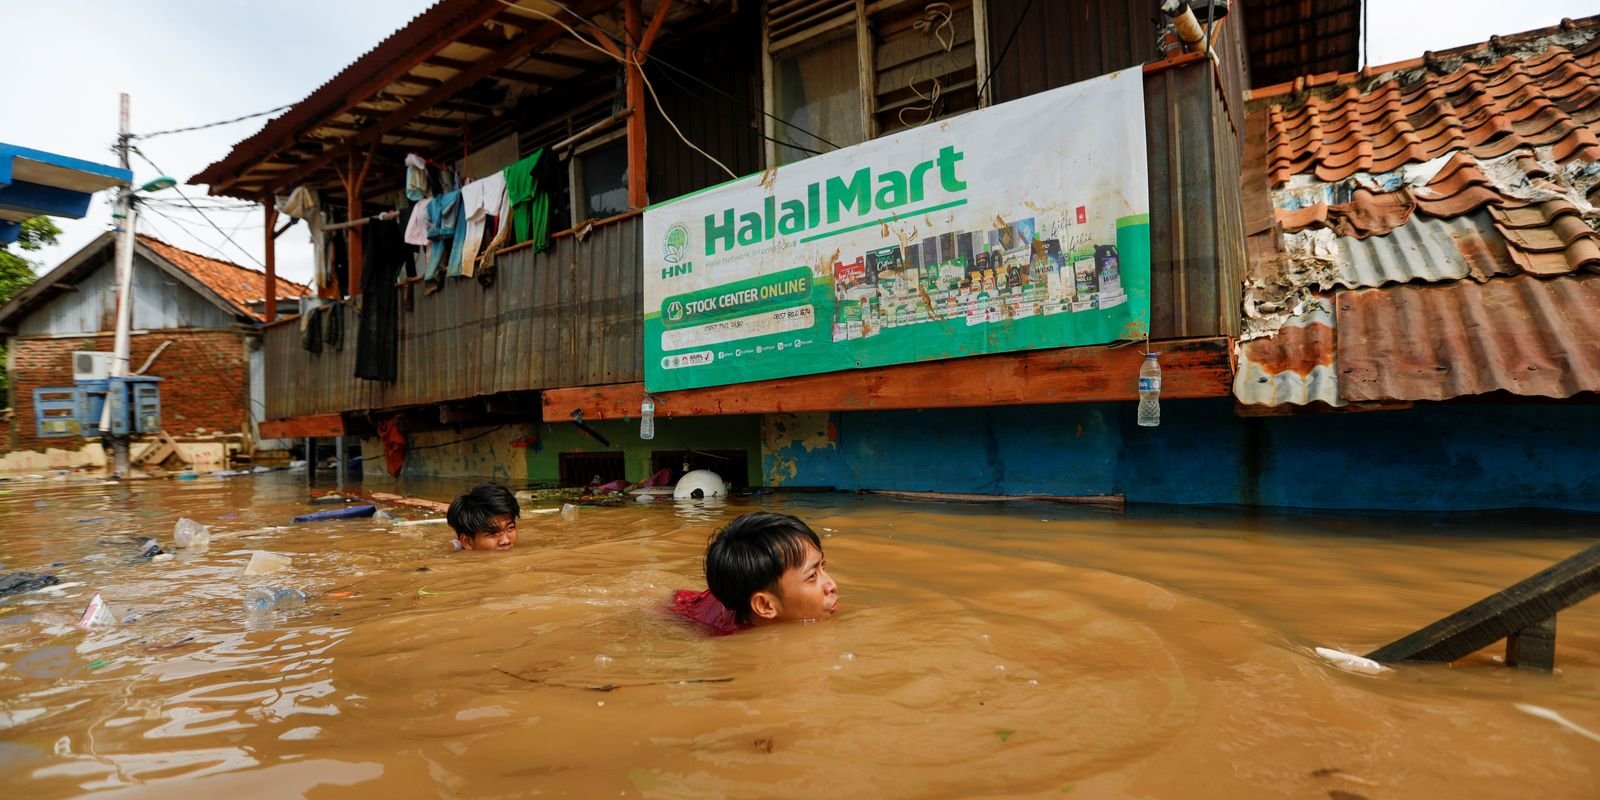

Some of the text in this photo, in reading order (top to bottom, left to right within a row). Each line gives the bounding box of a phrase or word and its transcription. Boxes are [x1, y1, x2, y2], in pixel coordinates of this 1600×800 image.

[704, 145, 967, 256] HalalMart
[661, 262, 693, 279] HNI
[685, 278, 806, 315] STOCK CENTER ONLINE
